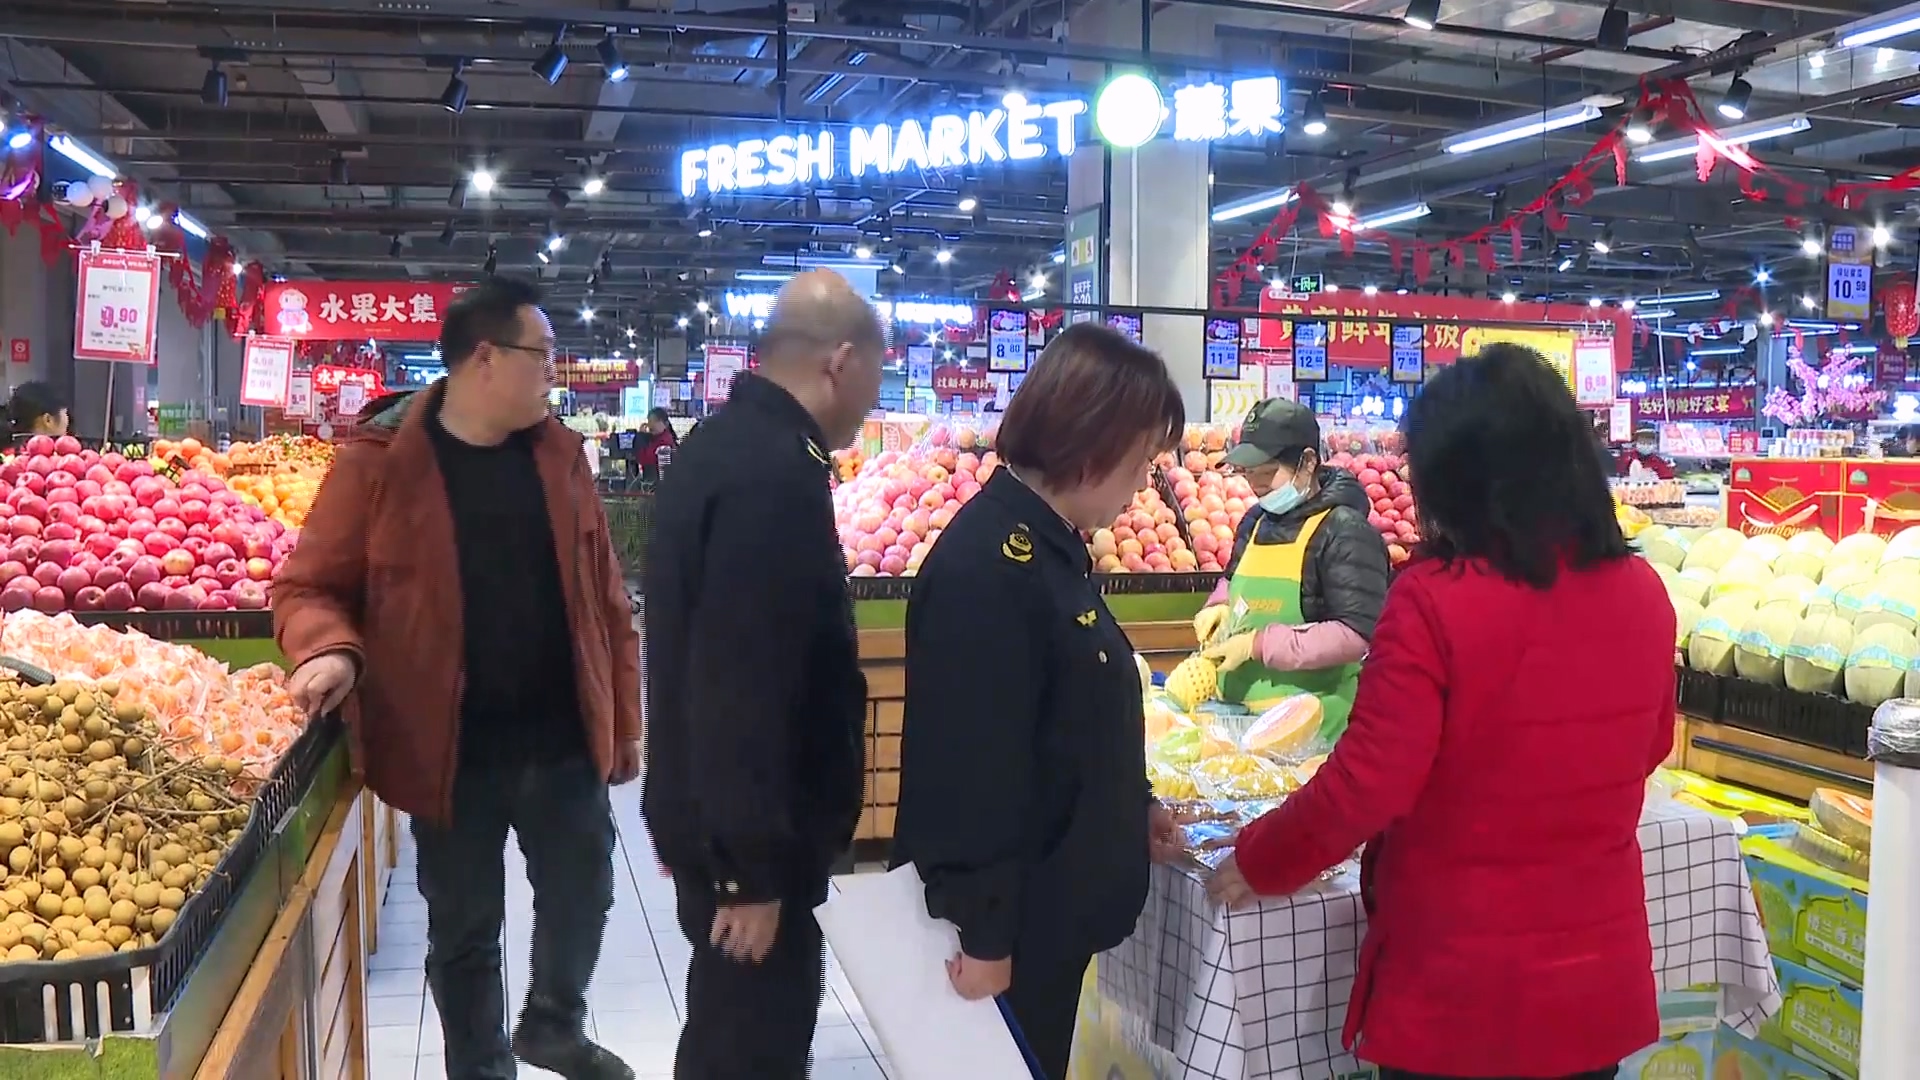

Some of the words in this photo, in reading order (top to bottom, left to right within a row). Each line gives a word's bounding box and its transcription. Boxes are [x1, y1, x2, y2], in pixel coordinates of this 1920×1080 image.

[681, 130, 834, 197] FRESH
[849, 99, 1088, 177] MARKET
[318, 292, 438, 324] 水果大集
